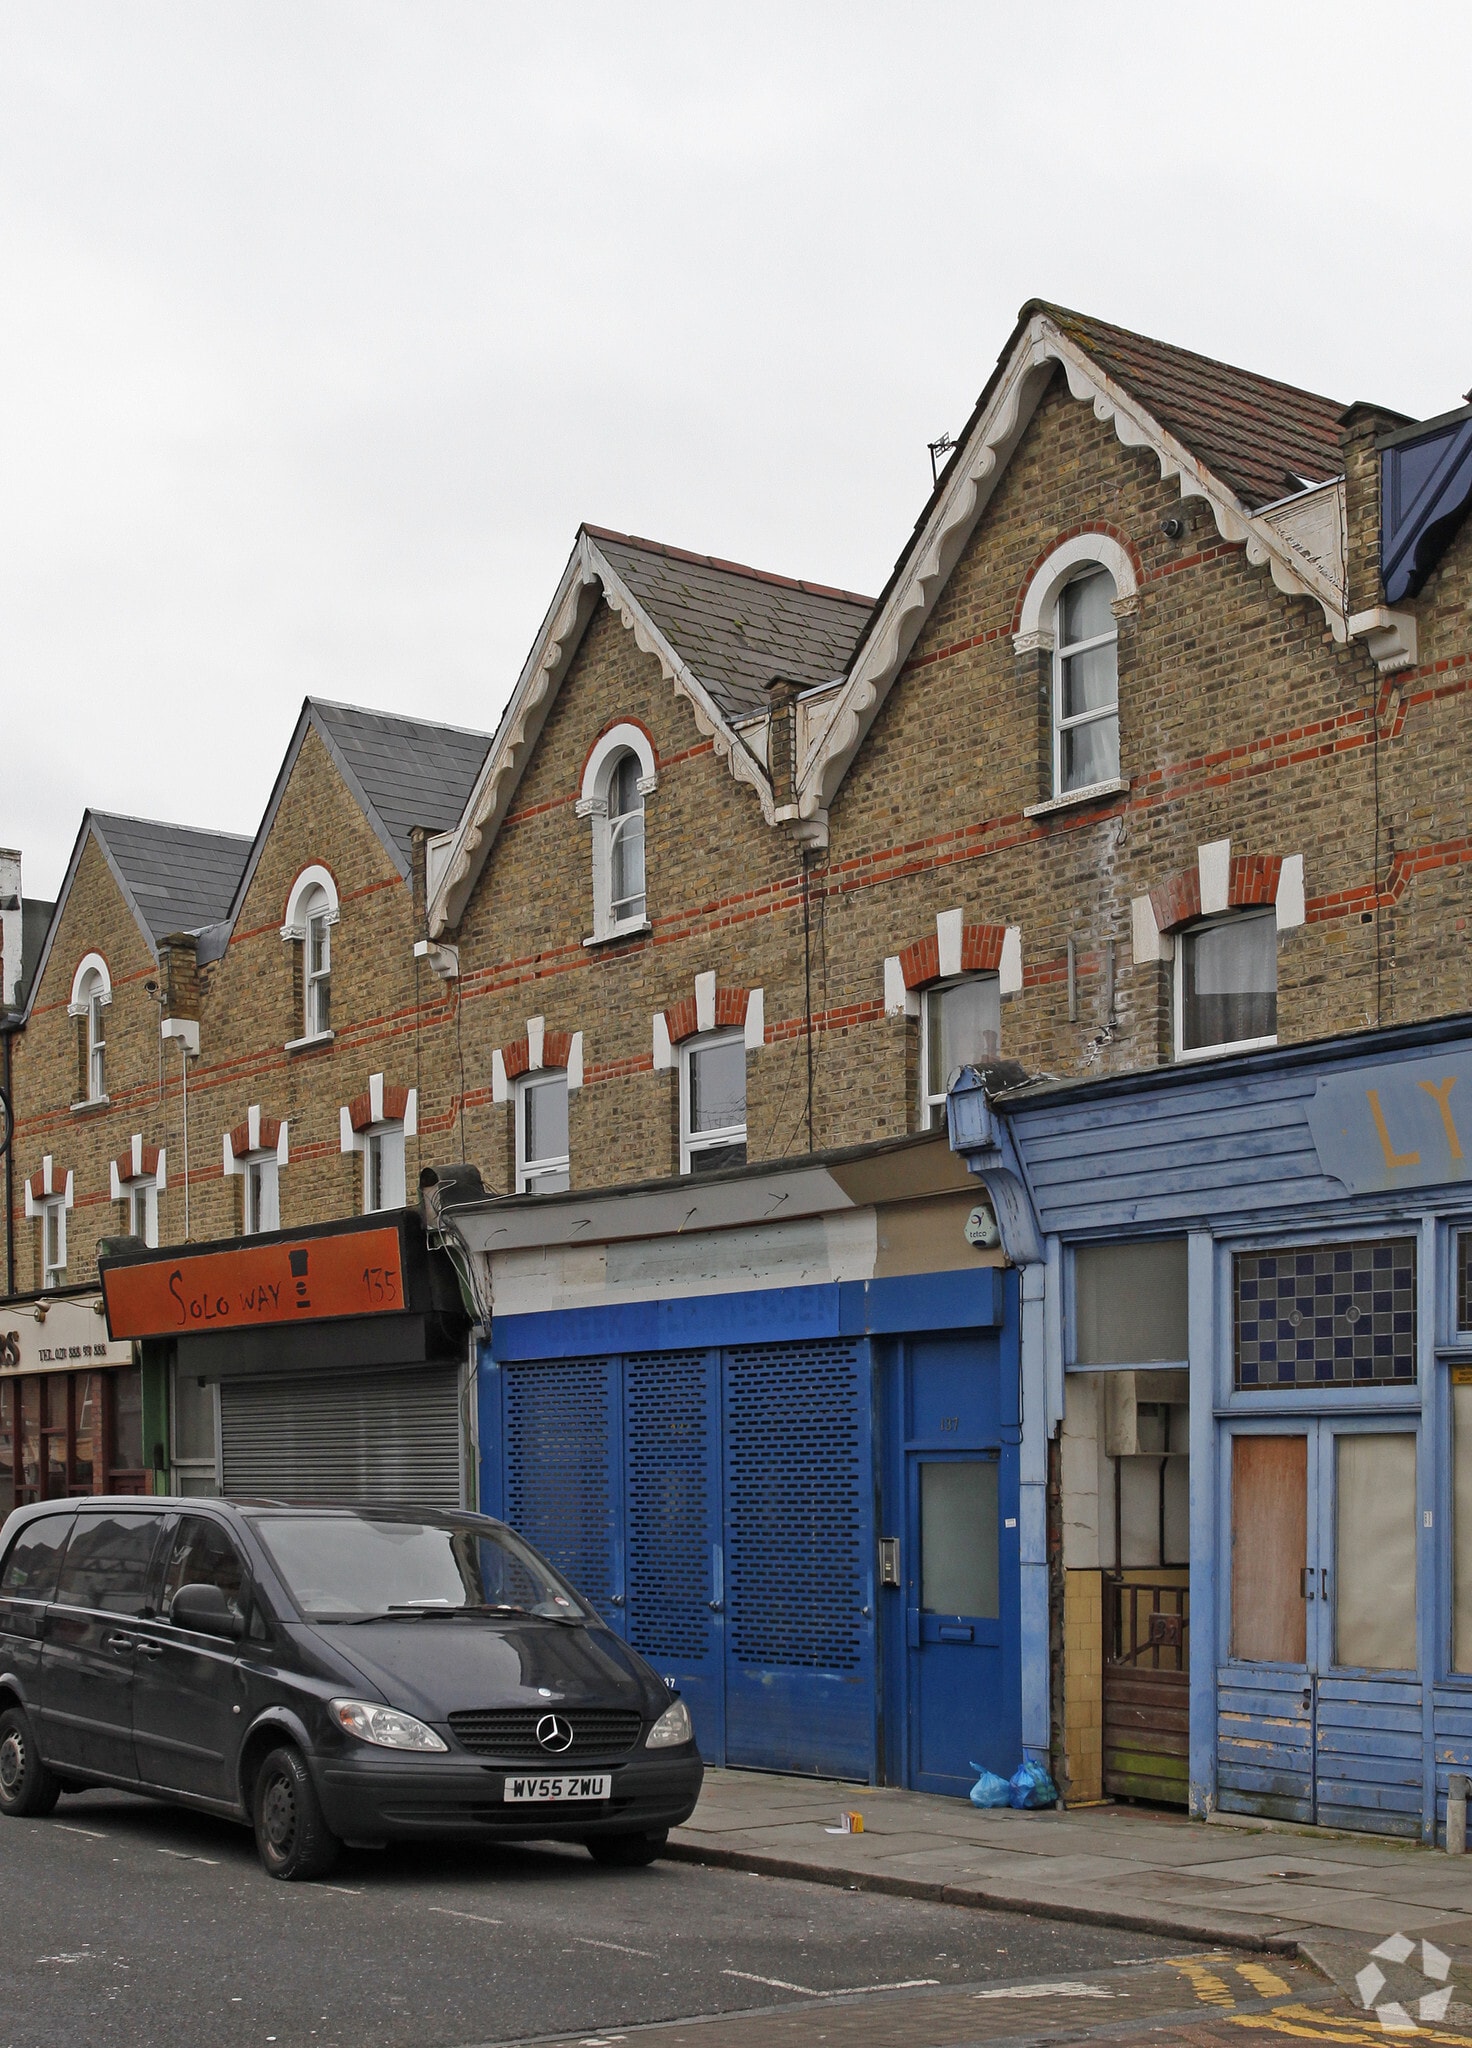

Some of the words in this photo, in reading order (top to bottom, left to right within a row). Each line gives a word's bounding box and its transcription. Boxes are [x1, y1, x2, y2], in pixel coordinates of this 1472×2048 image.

[1365, 1076, 1464, 1169] LY
[239, 1281, 282, 1312] WAY
[362, 1267, 397, 1303] 135
[940, 1416, 959, 1432] 137
[513, 1779, 563, 1797] WV55
[567, 1778, 604, 1796] ZWU
